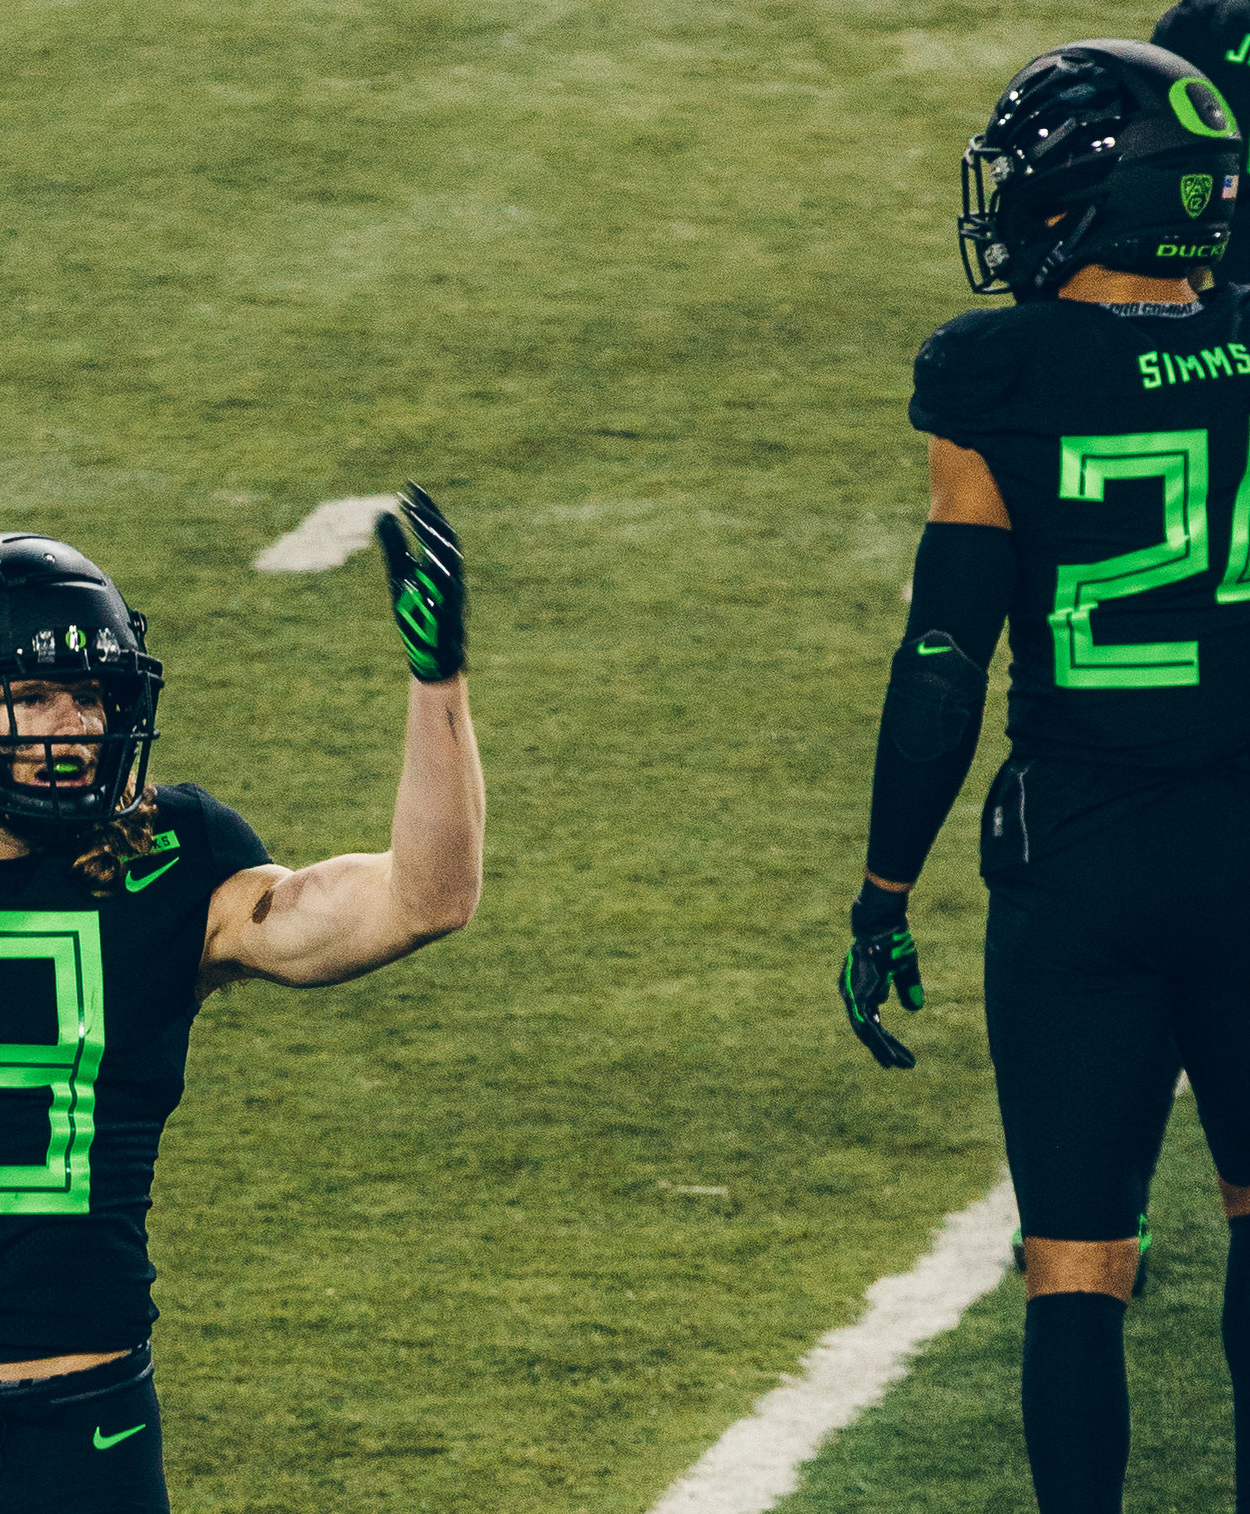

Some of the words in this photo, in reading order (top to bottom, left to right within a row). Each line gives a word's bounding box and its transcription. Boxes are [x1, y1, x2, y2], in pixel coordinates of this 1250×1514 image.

[1225, 33, 1250, 66] J
[1138, 342, 1250, 390] SIMMS
[1047, 428, 1250, 688] 2
